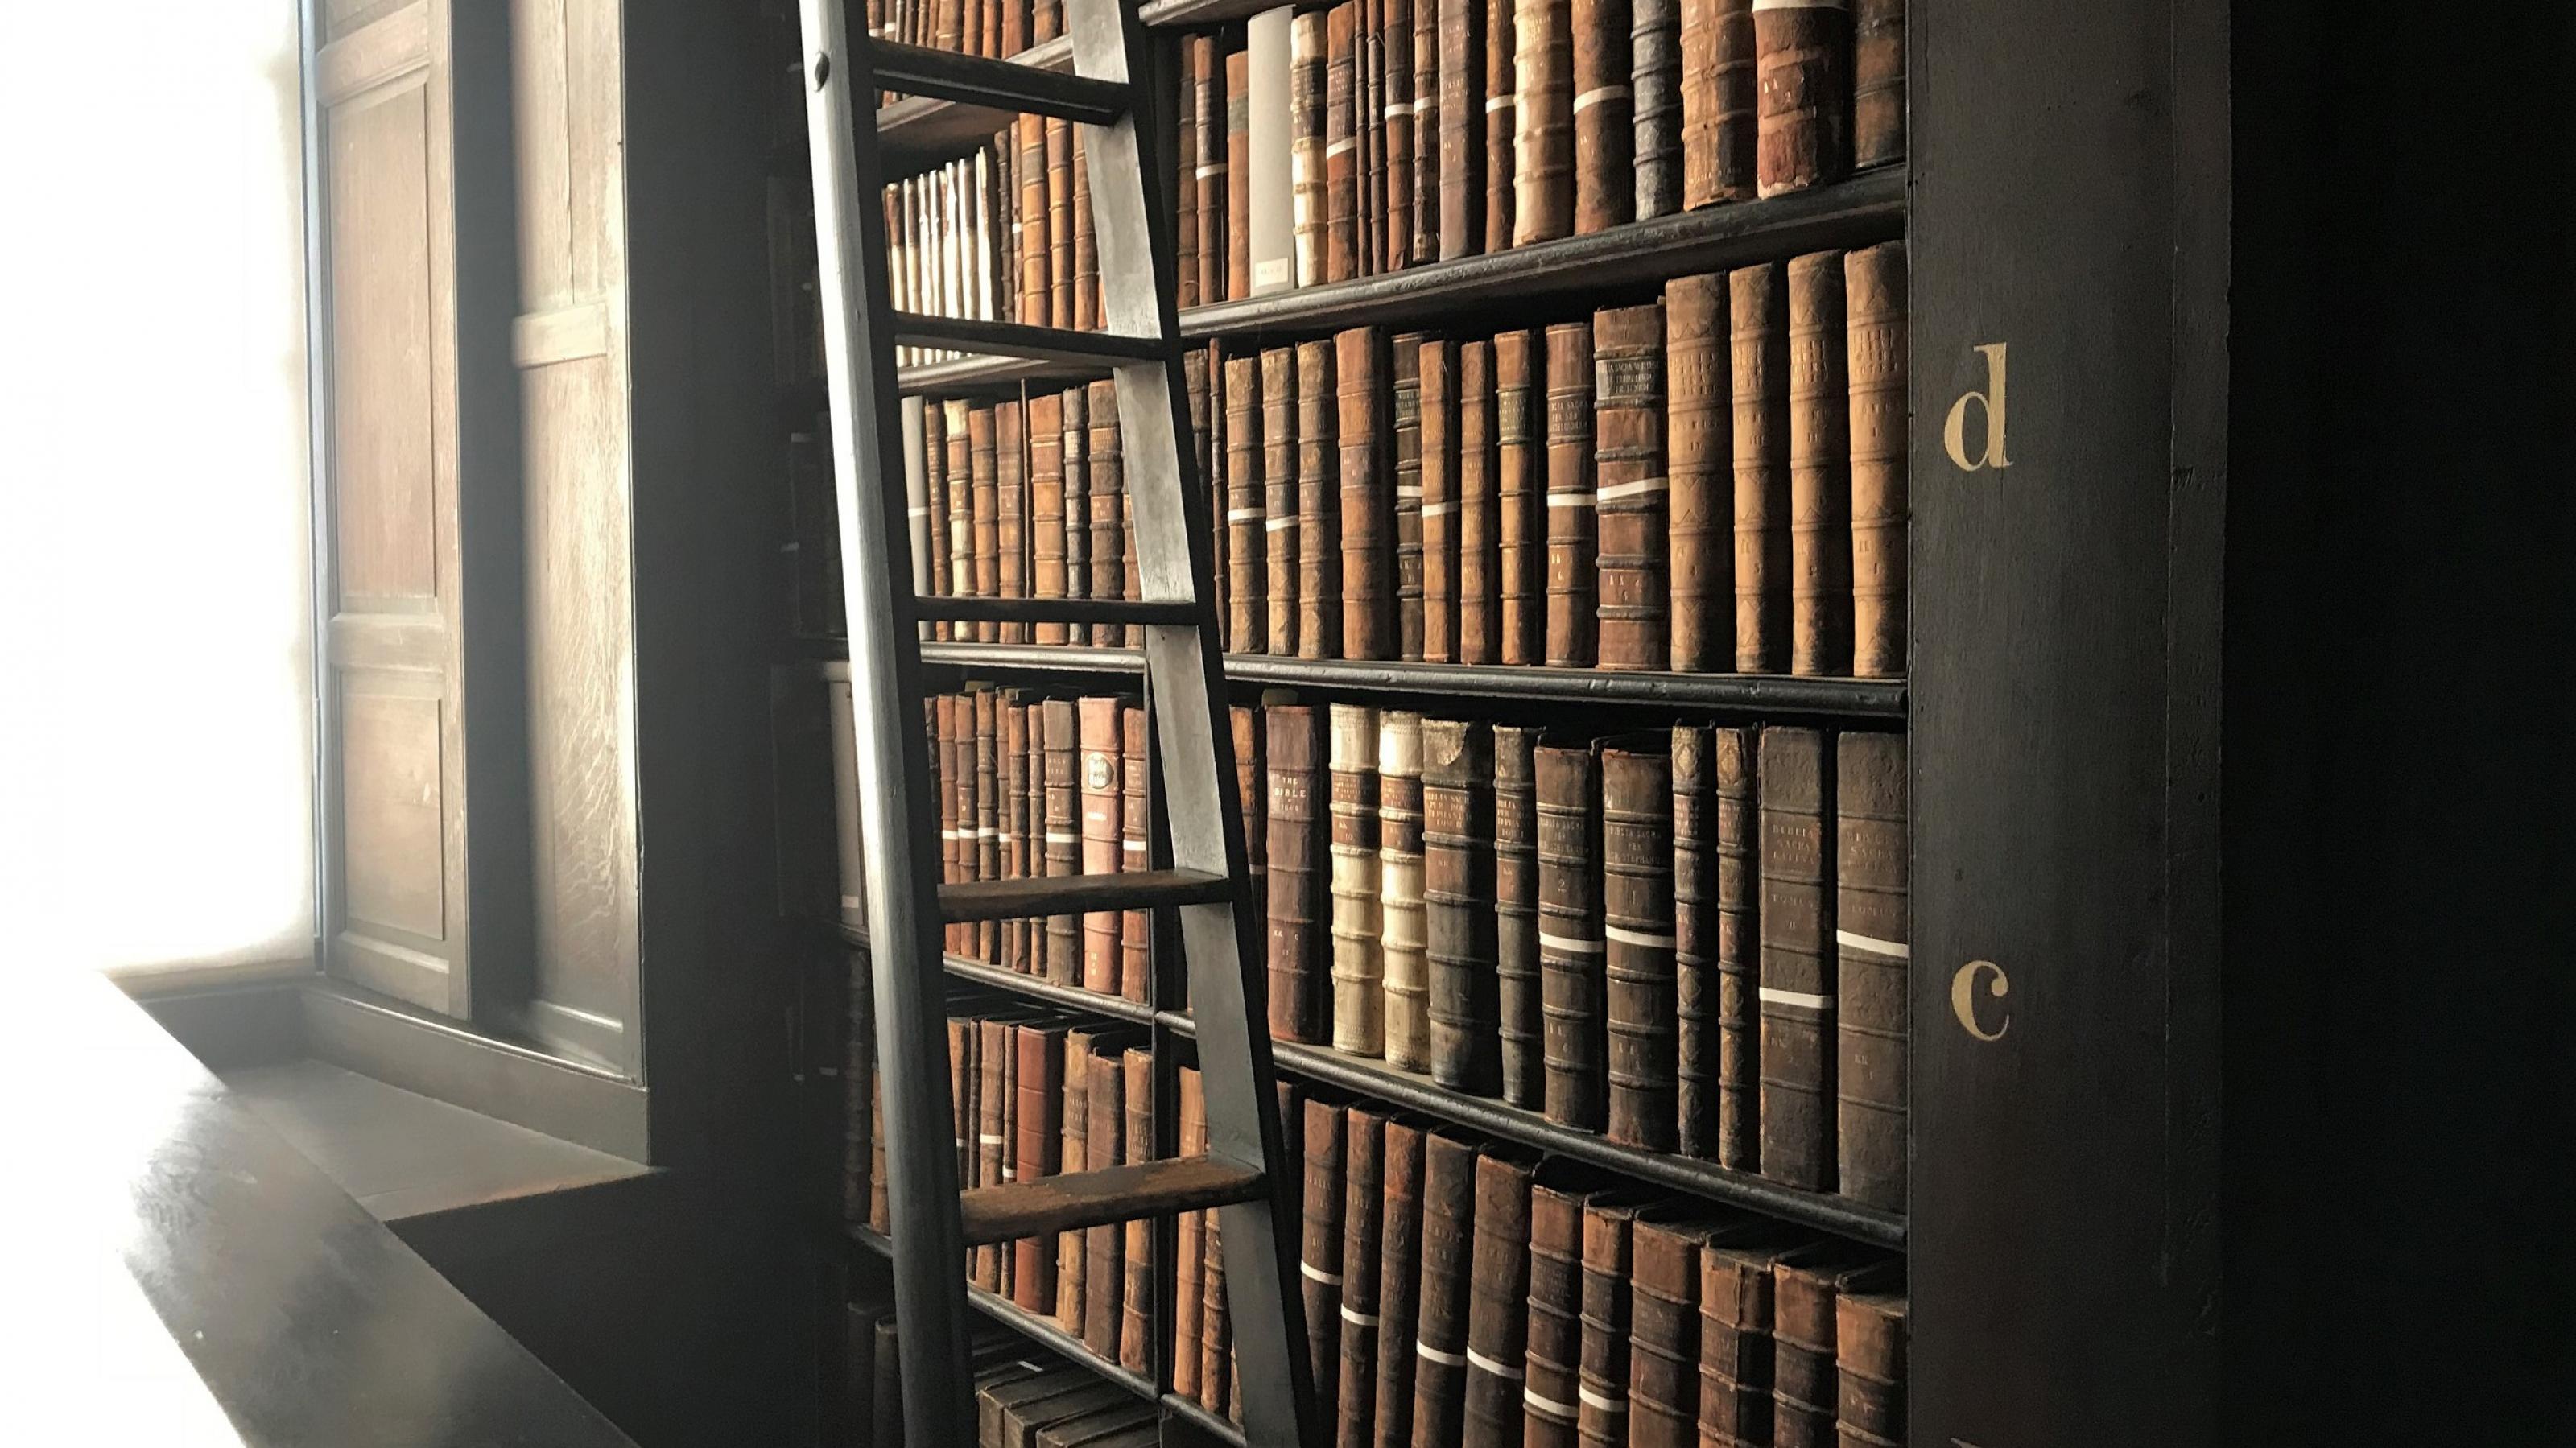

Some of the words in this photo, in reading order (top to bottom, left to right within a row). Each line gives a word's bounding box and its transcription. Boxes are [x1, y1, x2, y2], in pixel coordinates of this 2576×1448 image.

[1944, 341, 2013, 472] d
[1274, 787, 1307, 798] BIBLE
[1951, 959, 2010, 1041] c
